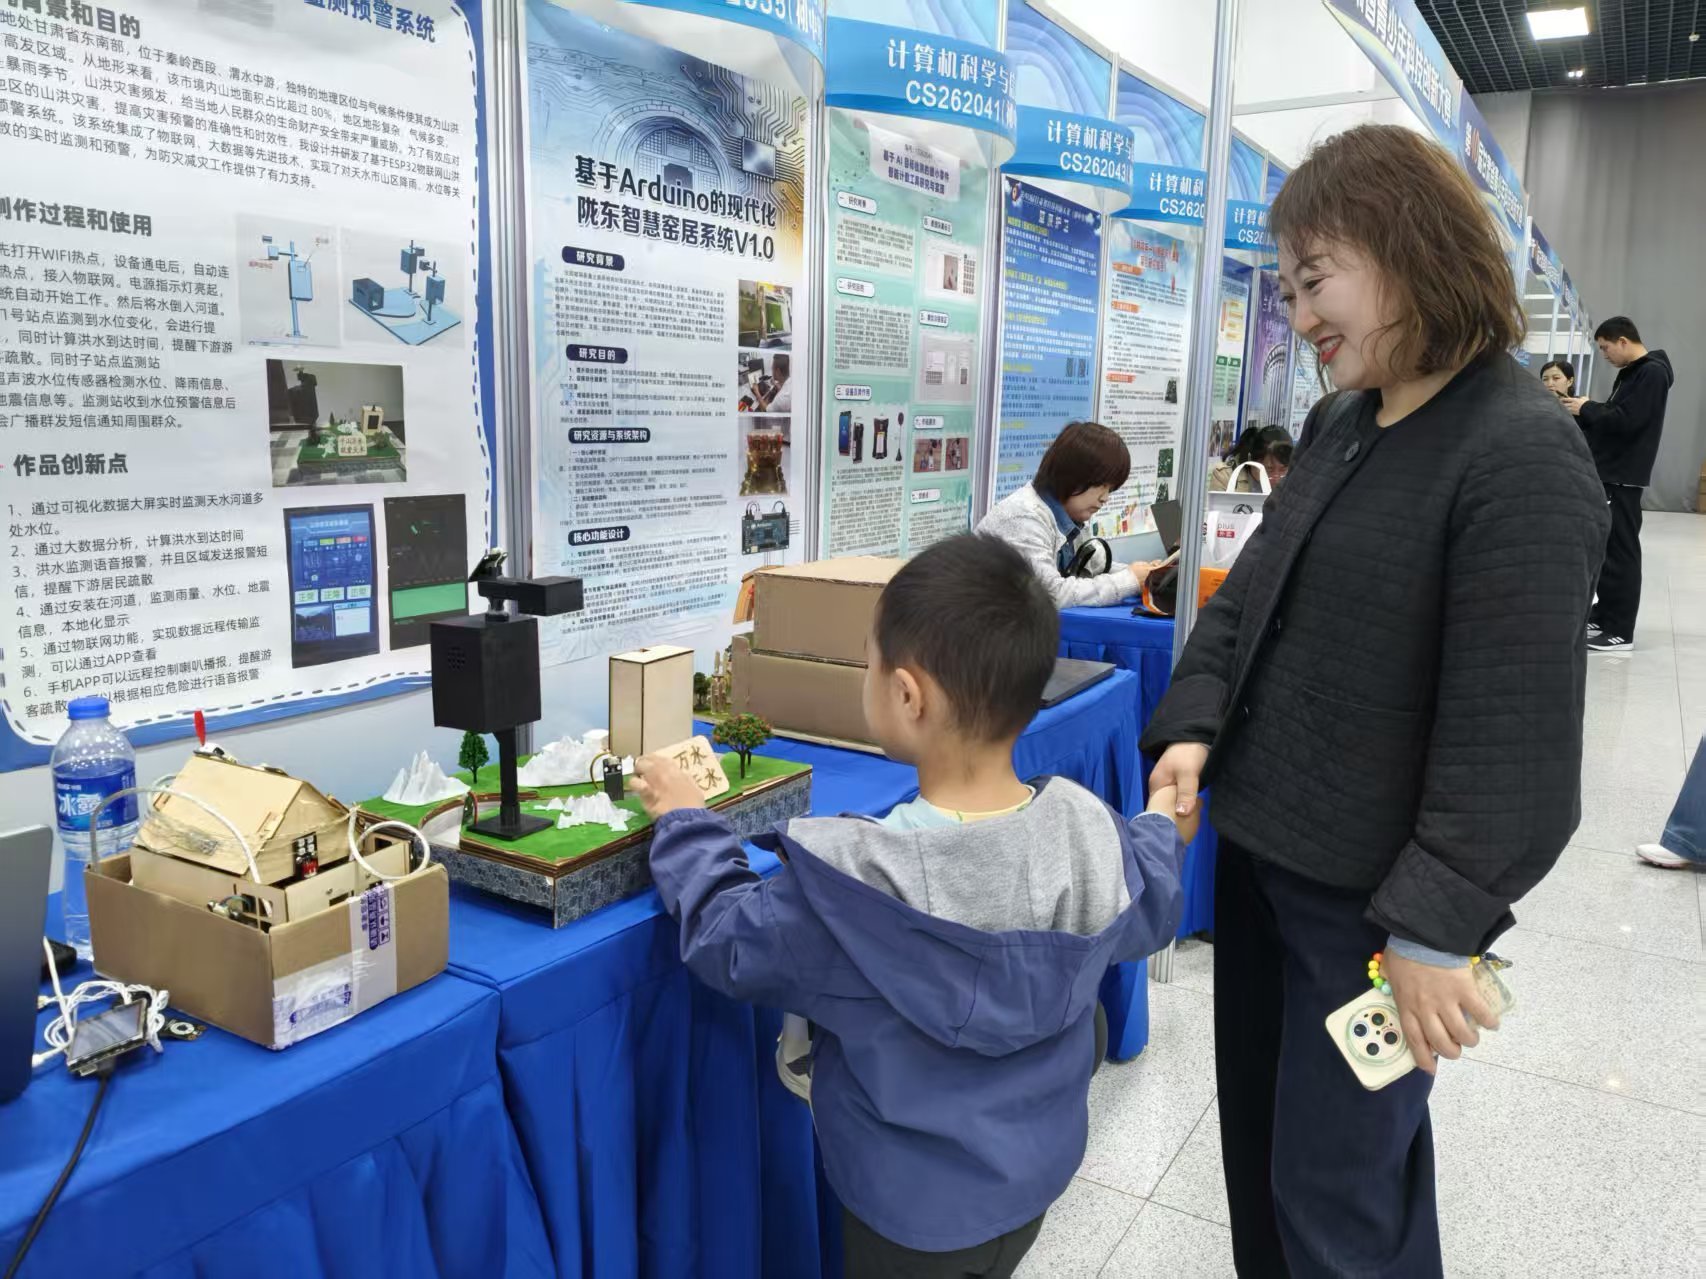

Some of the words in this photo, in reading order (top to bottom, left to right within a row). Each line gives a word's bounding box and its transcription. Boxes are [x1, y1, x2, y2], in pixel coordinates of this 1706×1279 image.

[8, 0, 141, 39] 背景和目的
[1356, 0, 1451, 128] 省青少年科技创新大赛
[0, 55, 459, 166] 暴雨季节，山洪灾害频发，给当地人民群众的生命财产安全带来严重威胁。为了有效应对
[574, 155, 777, 229] 基于Arduino的现代化
[576, 195, 775, 260] 陇东智慧窑居系统V1.0
[576, 250, 615, 267] 研究背景
[578, 347, 616, 361] 研究目的
[13, 453, 129, 476] 作品创新点
[9, 522, 62, 538] 处水位。
[573, 528, 625, 543] 核心功能设计
[25, 668, 260, 718] 客疏散以根据相应危险进行语音报警
